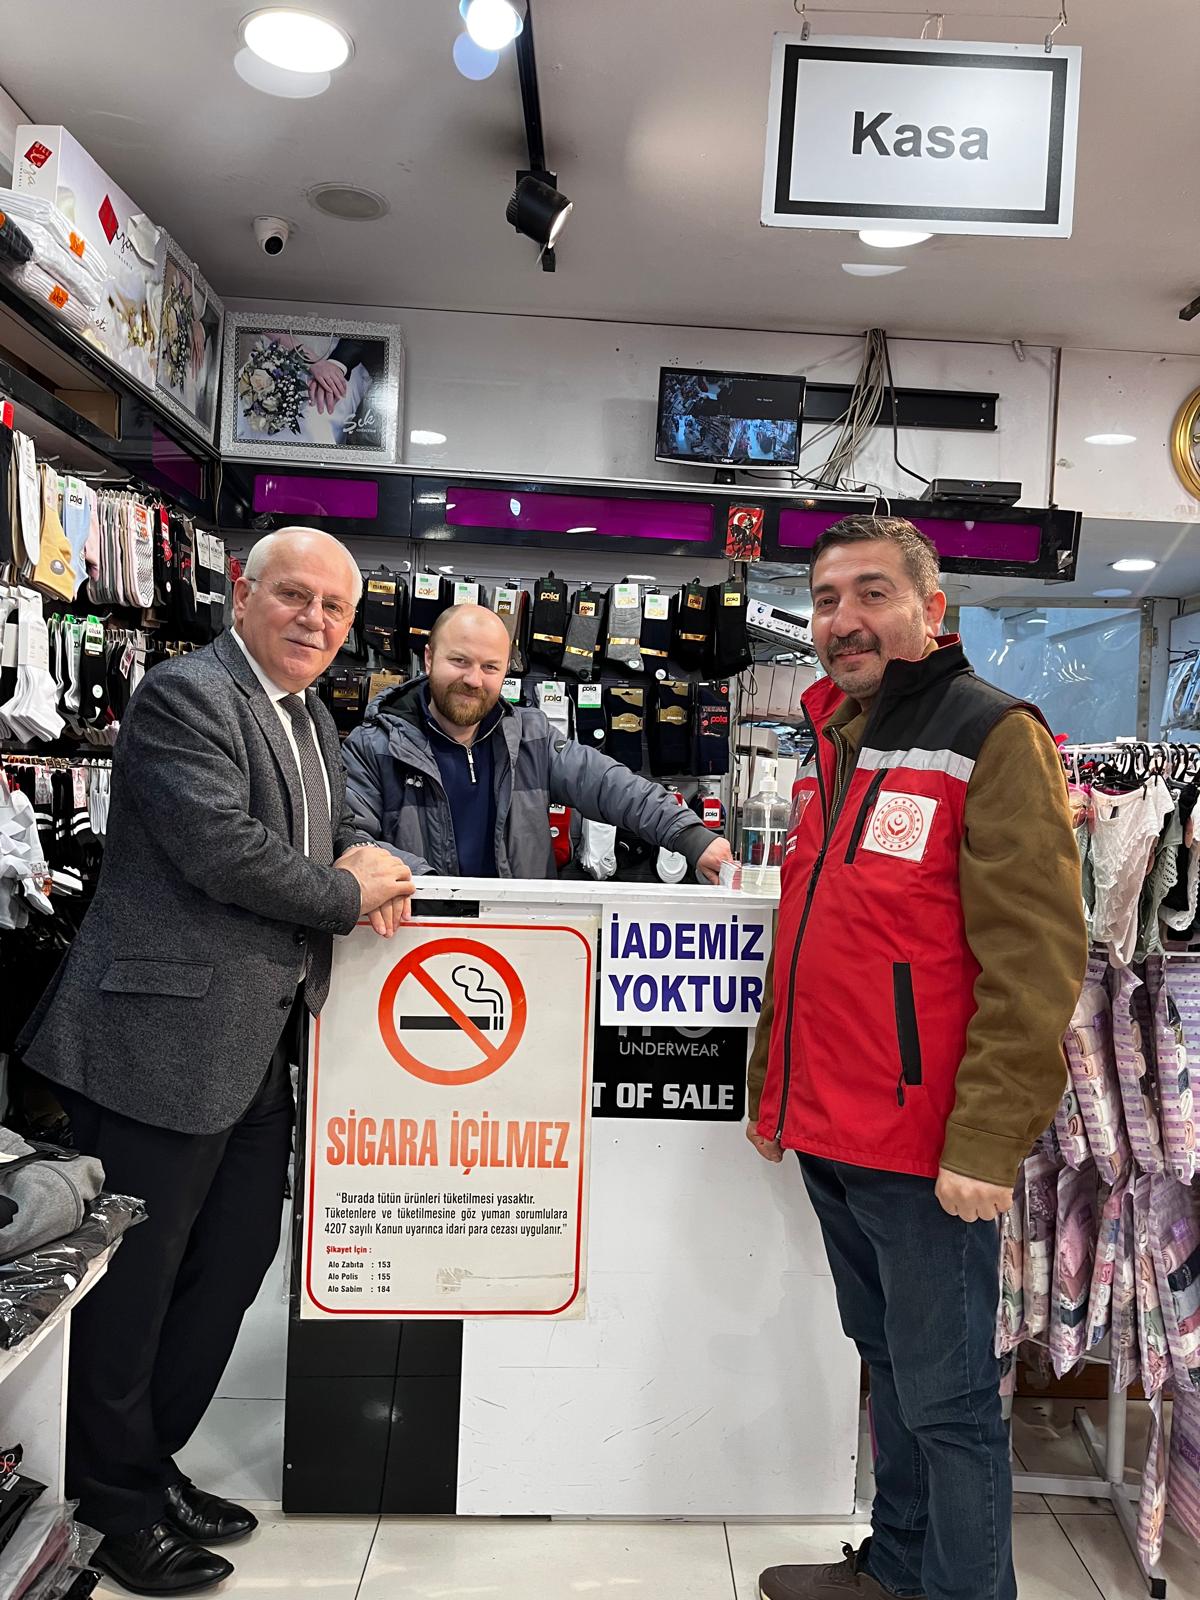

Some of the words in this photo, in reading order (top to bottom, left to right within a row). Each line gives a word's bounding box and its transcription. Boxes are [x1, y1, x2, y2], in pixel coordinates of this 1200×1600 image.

[851, 110, 990, 161] Kasa
[69, 493, 83, 505] pola
[541, 591, 560, 601] pola
[580, 605, 594, 614] pola
[582, 685, 597, 693] pola
[543, 693, 562, 704] pola
[710, 715, 728, 725] pola
[704, 810, 718, 818] pola
[610, 912, 764, 961] İADEMİZ
[608, 974, 763, 1014] YOKTUR
[619, 1041, 720, 1057] UNDERWEAR
[616, 1082, 653, 1109] OF
[662, 1083, 735, 1110] SALE
[326, 1109, 439, 1167] SİGARA
[449, 1110, 571, 1175] İÇİLMEZ
[377, 1192, 401, 1204] tütün
[404, 1192, 441, 1204] ürünleri
[443, 1193, 494, 1204] tüketilmesi
[497, 1193, 535, 1206] yasaktır.
[325, 1207, 376, 1219] Tüketenlere
[381, 1209, 392, 1219] ve
[397, 1207, 456, 1219] tüketilmesine
[461, 1208, 476, 1221] göz
[481, 1210, 511, 1221] yuman
[515, 1208, 568, 1219] sorumlulara
[324, 1222, 347, 1234] 4207
[349, 1223, 373, 1237] sayılı
[375, 1223, 403, 1235] Kanun
[405, 1224, 443, 1237] uyarınca
[446, 1223, 466, 1234] idari
[468, 1225, 488, 1236] para
[490, 1225, 518, 1235] cezası
[326, 1245, 352, 1255] Şikayet
[354, 1245, 367, 1255] İçin
[327, 1285, 339, 1293] Alo
[377, 1285, 391, 1293] 184
